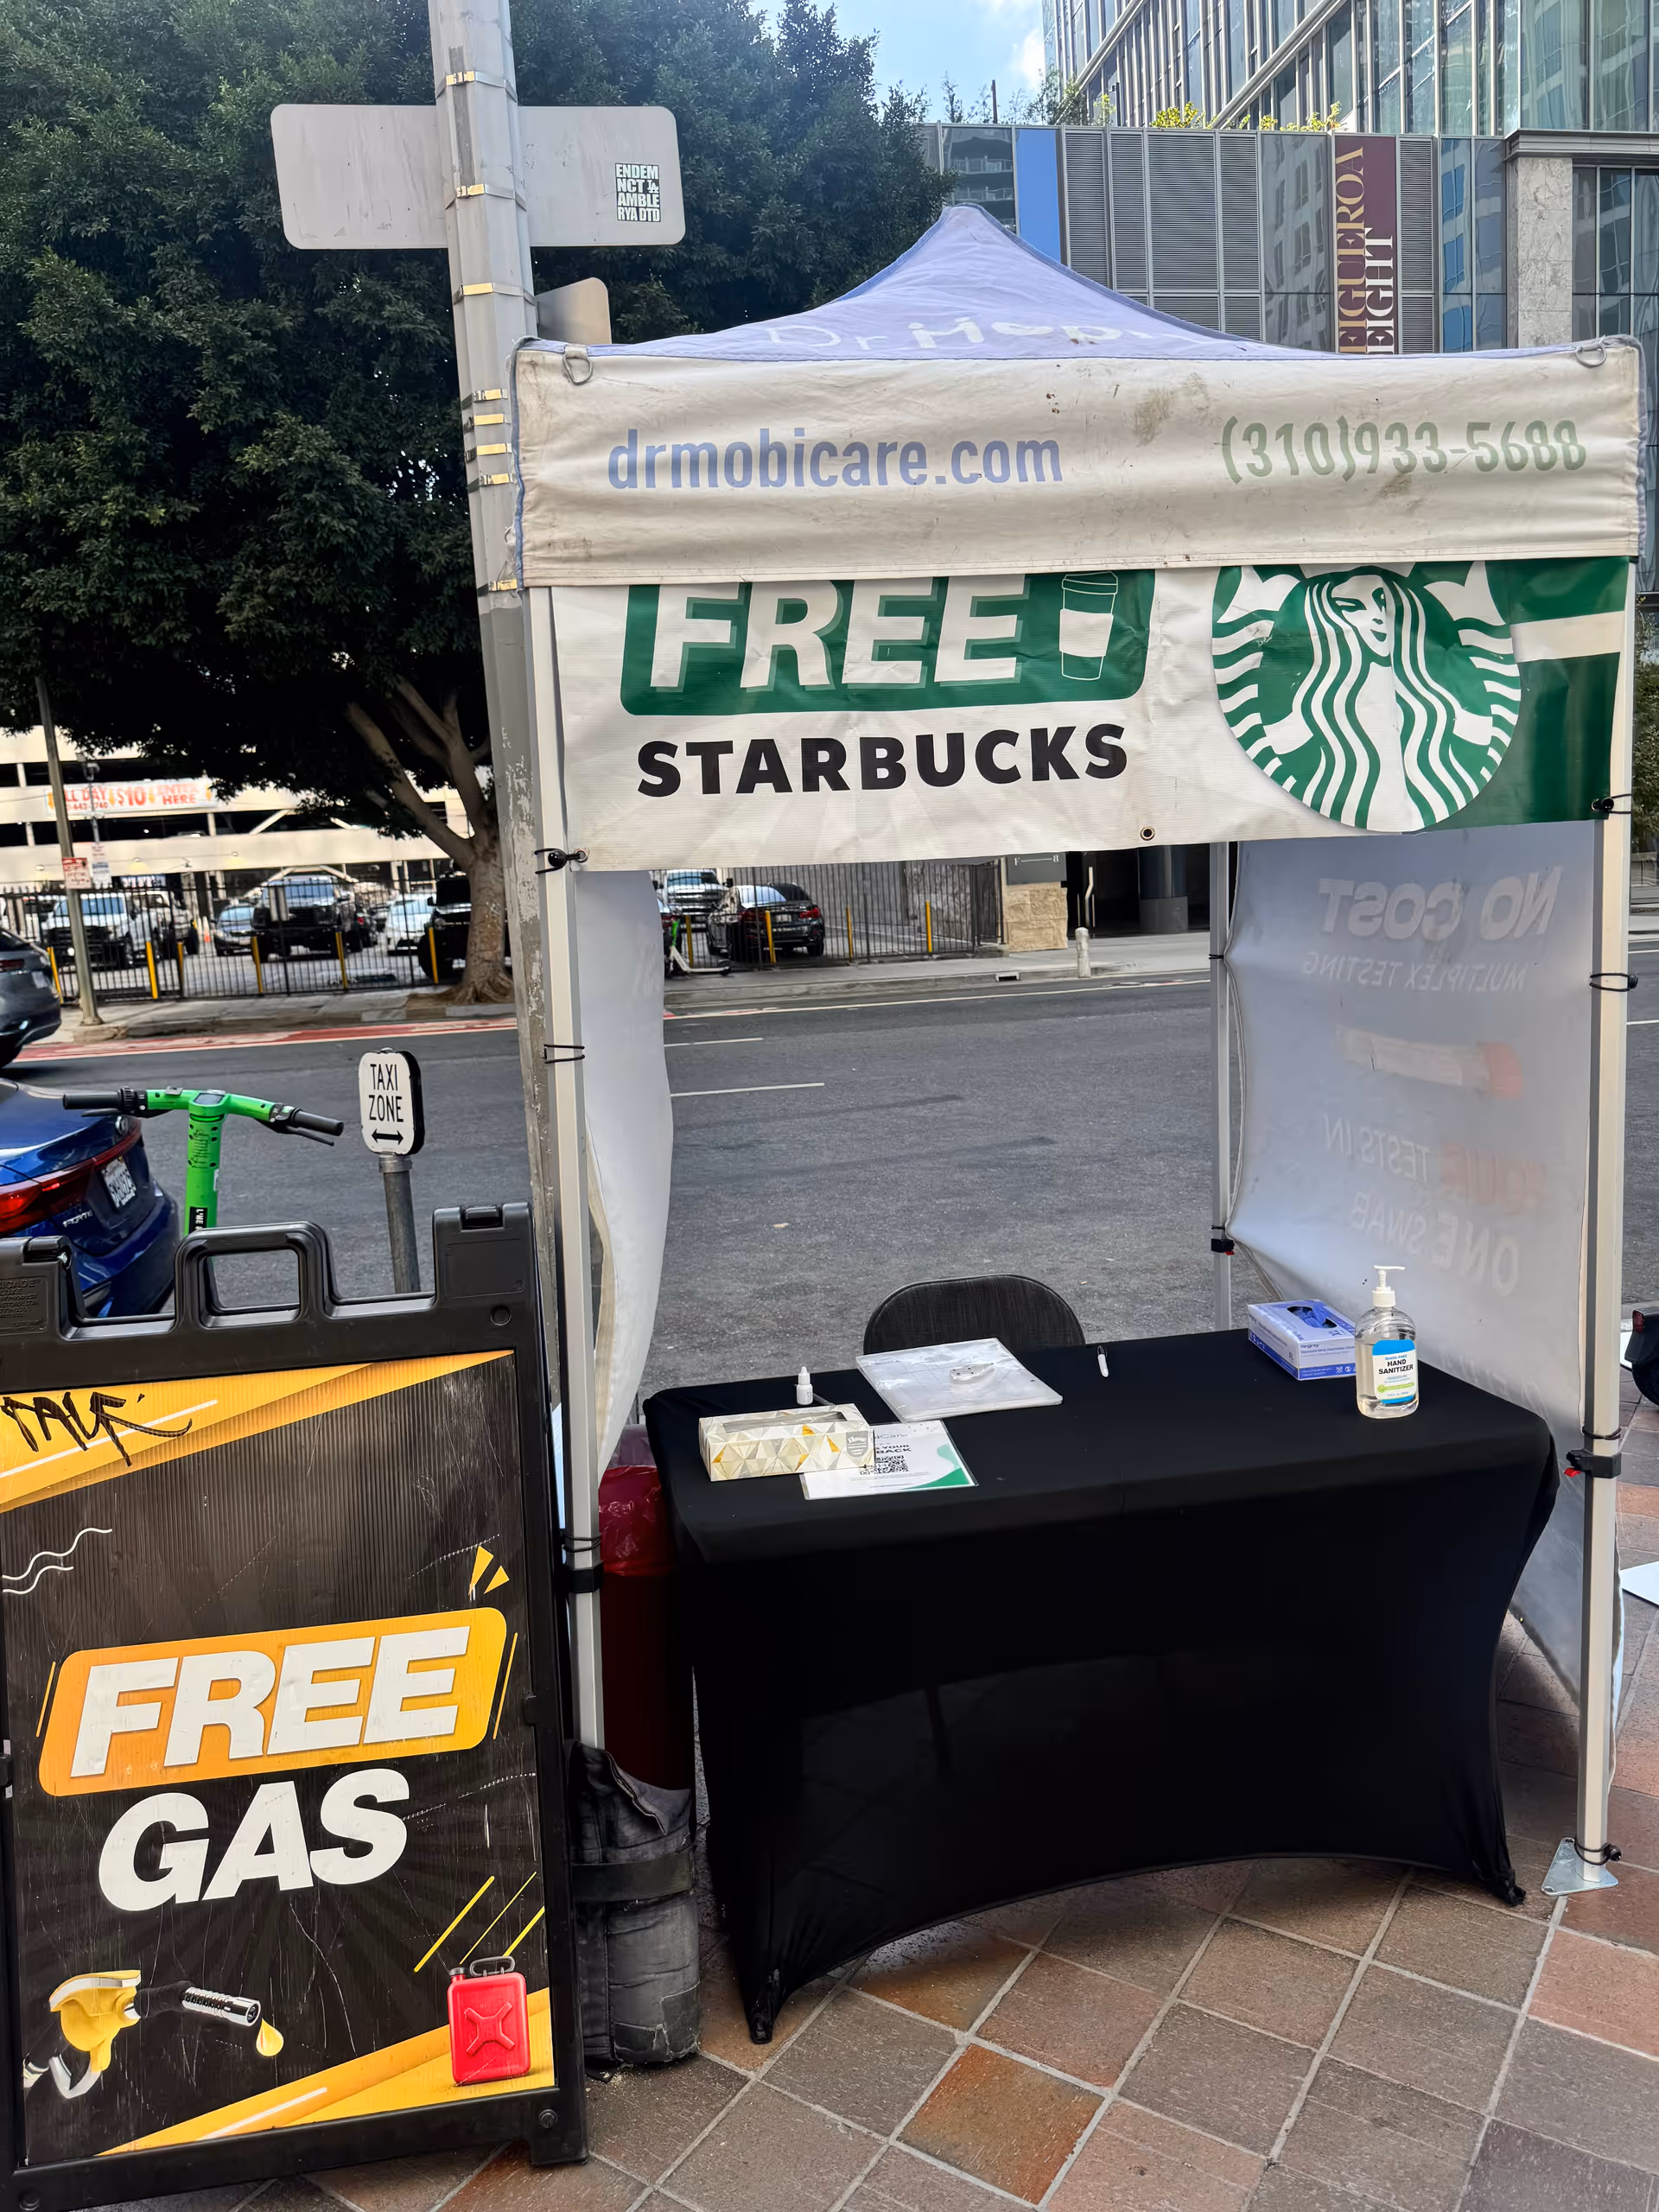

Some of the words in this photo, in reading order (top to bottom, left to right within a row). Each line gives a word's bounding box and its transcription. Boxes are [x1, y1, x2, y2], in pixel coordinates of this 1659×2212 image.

[615, 163, 658, 180] ENDEM
[617, 178, 645, 193] NCT
[618, 192, 660, 208] AMBLE
[617, 207, 639, 221] RYA
[1335, 146, 1367, 353] FIGUEROA
[1364, 226, 1394, 353] EIGHT
[607, 428, 1064, 489] drmobicare.com
[1221, 415, 1587, 485] (310)933-5688
[650, 574, 1029, 690] FREE
[637, 723, 1128, 798] STARBUCKS
[65, 788, 79, 802] LL
[118, 785, 146, 806] $10
[162, 793, 197, 805] HERE
[370, 1064, 398, 1090] TAXI
[368, 1094, 404, 1122] ZONE
[1378, 1364, 1414, 1375] SANITIZER
[70, 1625, 471, 1778] FREE
[98, 1768, 410, 1912] GAS
